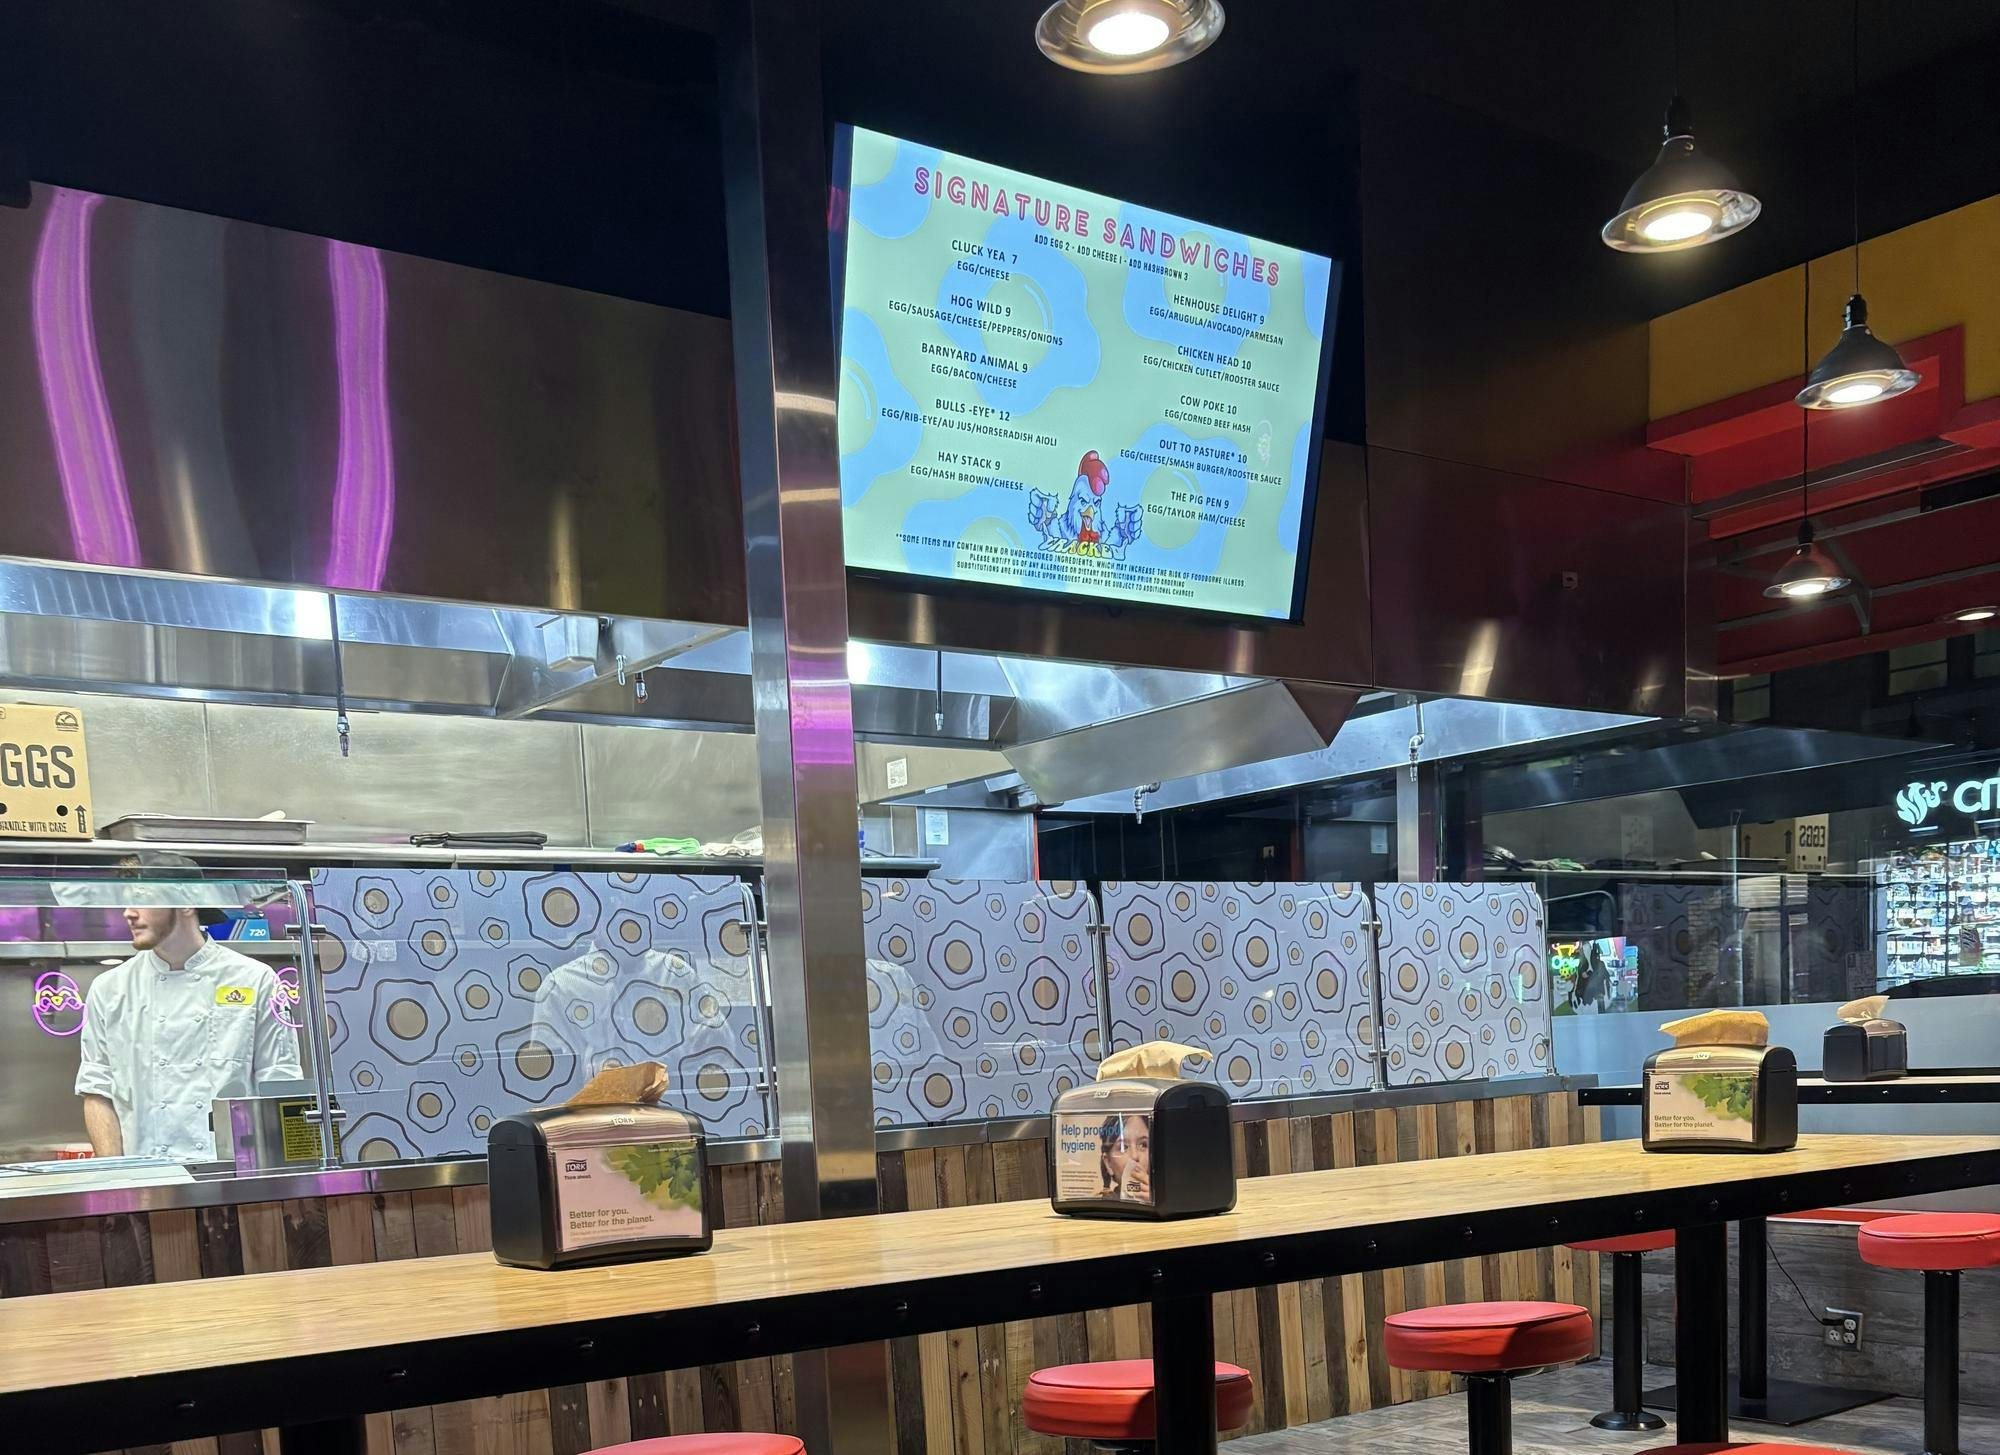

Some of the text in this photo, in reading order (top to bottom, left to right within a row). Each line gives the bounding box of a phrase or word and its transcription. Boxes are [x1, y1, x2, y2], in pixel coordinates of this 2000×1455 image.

[914, 167, 1279, 286] SIGNATURE SANDWICHES
[952, 239, 1018, 265] CLUCK YEA 7
[1034, 234, 1048, 245] ADD
[1050, 238, 1064, 250] EGG
[1065, 242, 1070, 251] 2
[1077, 245, 1091, 256] ADD
[1092, 248, 1118, 264] CHEESE
[1128, 258, 1142, 269] ADD
[1143, 262, 1183, 280] HASHBROWN
[957, 260, 1010, 281] EGG/CHEESE
[951, 294, 1011, 317] HOG WILD 9
[1173, 294, 1265, 325] HENHOUSE DELIGHT 9
[889, 300, 1063, 346] EGG/SAUSAGE/CHEESE/PEPPERS/ONIONS
[1149, 306, 1284, 346] EGG/ARUGULA/AVOCADO/PARMESAN
[921, 342, 1028, 373] BARNYARD ANIMAL 9
[1177, 345, 1252, 370] CHICKEN HEAD 10
[931, 363, 1017, 388] EGG/BACON/CHEESE
[1143, 355, 1280, 393] EGG/CHICKEN CUTLET/ROOSTER SAUCE
[935, 398, 965, 413] BULLS
[999, 410, 1010, 422] 12
[1180, 395, 1237, 415] COW POKE 10
[881, 408, 1057, 447] EGG/RIB-EYE/AU JUS/HORSERADISH AIOLI
[1164, 409, 1251, 433] EGG/CORNED BEEF HASH
[938, 451, 1001, 470] HAY STACK 9
[1159, 439, 1178, 450] OUT
[1180, 443, 1191, 454] TO
[1238, 454, 1247, 464] 10
[910, 466, 1024, 491] EGG/HASH BROWN/CHEESE
[1120, 449, 1282, 486] EGG/CHEESE/SMASH BURGER/ROOSTER SAUCE
[1171, 491, 1229, 510] THE PIG PEN 9
[1147, 504, 1246, 528] EGG/TAYLOR HAM/CHEESE
[921, 537, 941, 547] ITEMS
[942, 539, 955, 549] MAY
[956, 541, 983, 552] CONTAIN
[985, 545, 998, 554] RAW
[1000, 547, 1009, 555] OR
[1010, 548, 1053, 562] UNDERCOOKED
[1096, 558, 1115, 569] WHICH
[1116, 562, 1127, 571] MAY
[1129, 564, 1155, 576] INCREASE
[1157, 568, 1167, 577] THE
[1169, 570, 1181, 578] RISK
[1183, 572, 1190, 580] OF
[957, 561, 999, 573] SUBSTITUTIONS
[1001, 566, 1011, 574] ARE
[1013, 567, 1040, 579] AVAILABLE
[970, 553, 990, 563] PLEASE
[992, 555, 1010, 565] NOTIFY
[1012, 558, 1019, 566] US
[1028, 560, 1039, 569] ANY
[1040, 562, 1068, 572] ALLERGIES
[1062, 1124, 1081, 1138] Help
[1062, 1140, 1096, 1153] hygiene
[566, 1163, 586, 1172] TORK
[569, 1208, 629, 1219] Better for you.
[570, 1215, 654, 1230] Better for the planet.
